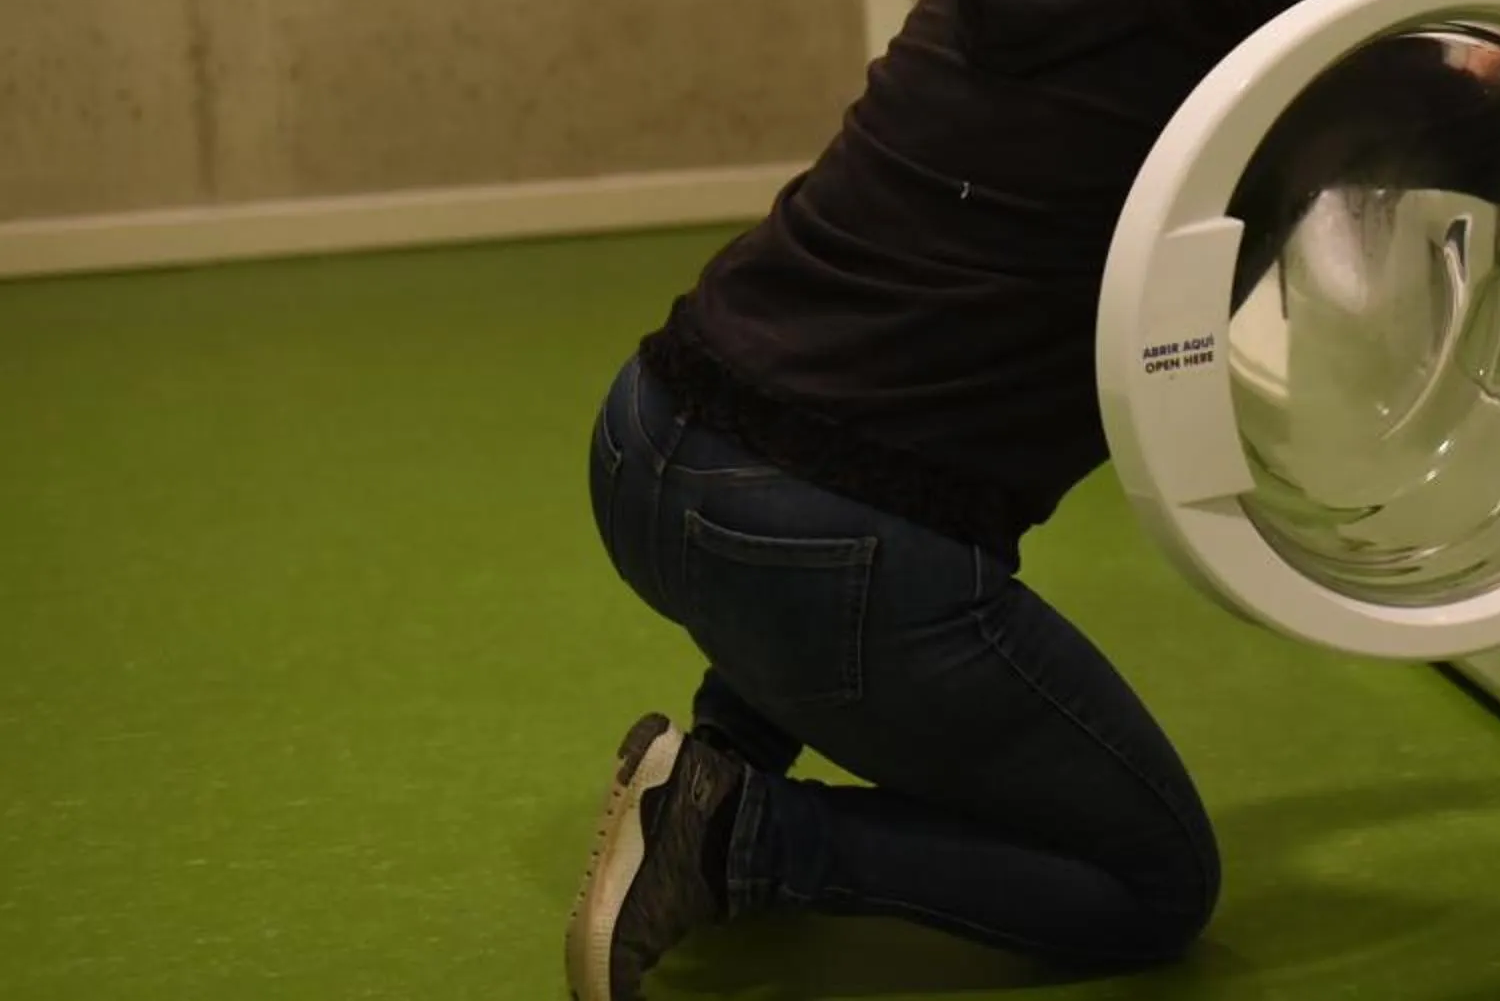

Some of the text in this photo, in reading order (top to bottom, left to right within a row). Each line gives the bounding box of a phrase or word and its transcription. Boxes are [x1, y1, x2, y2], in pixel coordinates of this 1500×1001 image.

[1143, 342, 1178, 360] ABRIR
[1145, 350, 1213, 374] OPEN HERE
